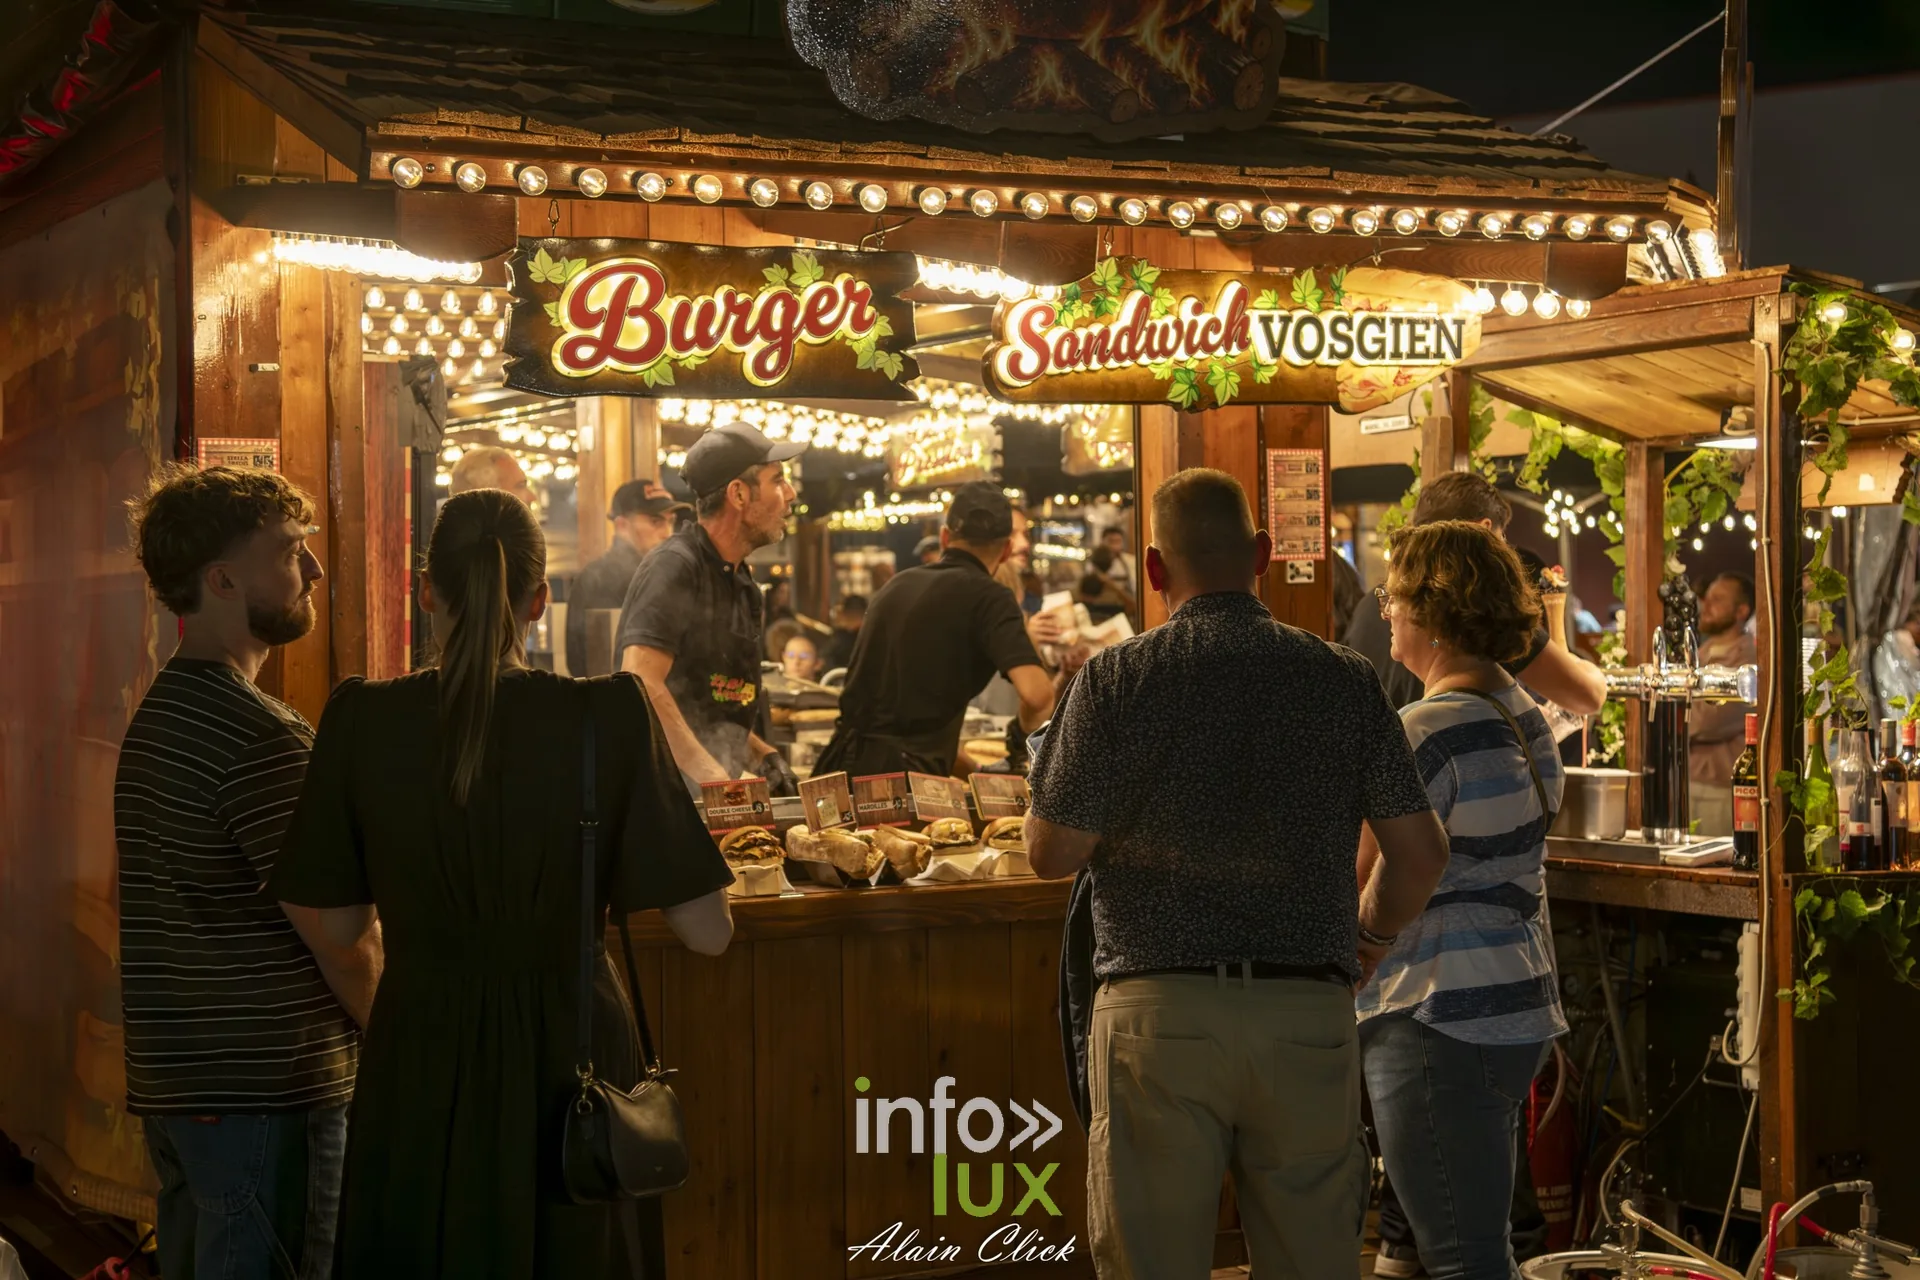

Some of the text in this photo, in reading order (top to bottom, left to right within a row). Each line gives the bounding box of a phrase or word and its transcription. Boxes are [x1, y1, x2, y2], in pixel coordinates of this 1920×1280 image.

[558, 262, 877, 382] Burger
[1006, 282, 1467, 382] Sandwich VOSGIEN
[709, 807, 731, 815] DOUBLE
[731, 805, 752, 813] CHEESE
[1735, 787, 1758, 795] PICO
